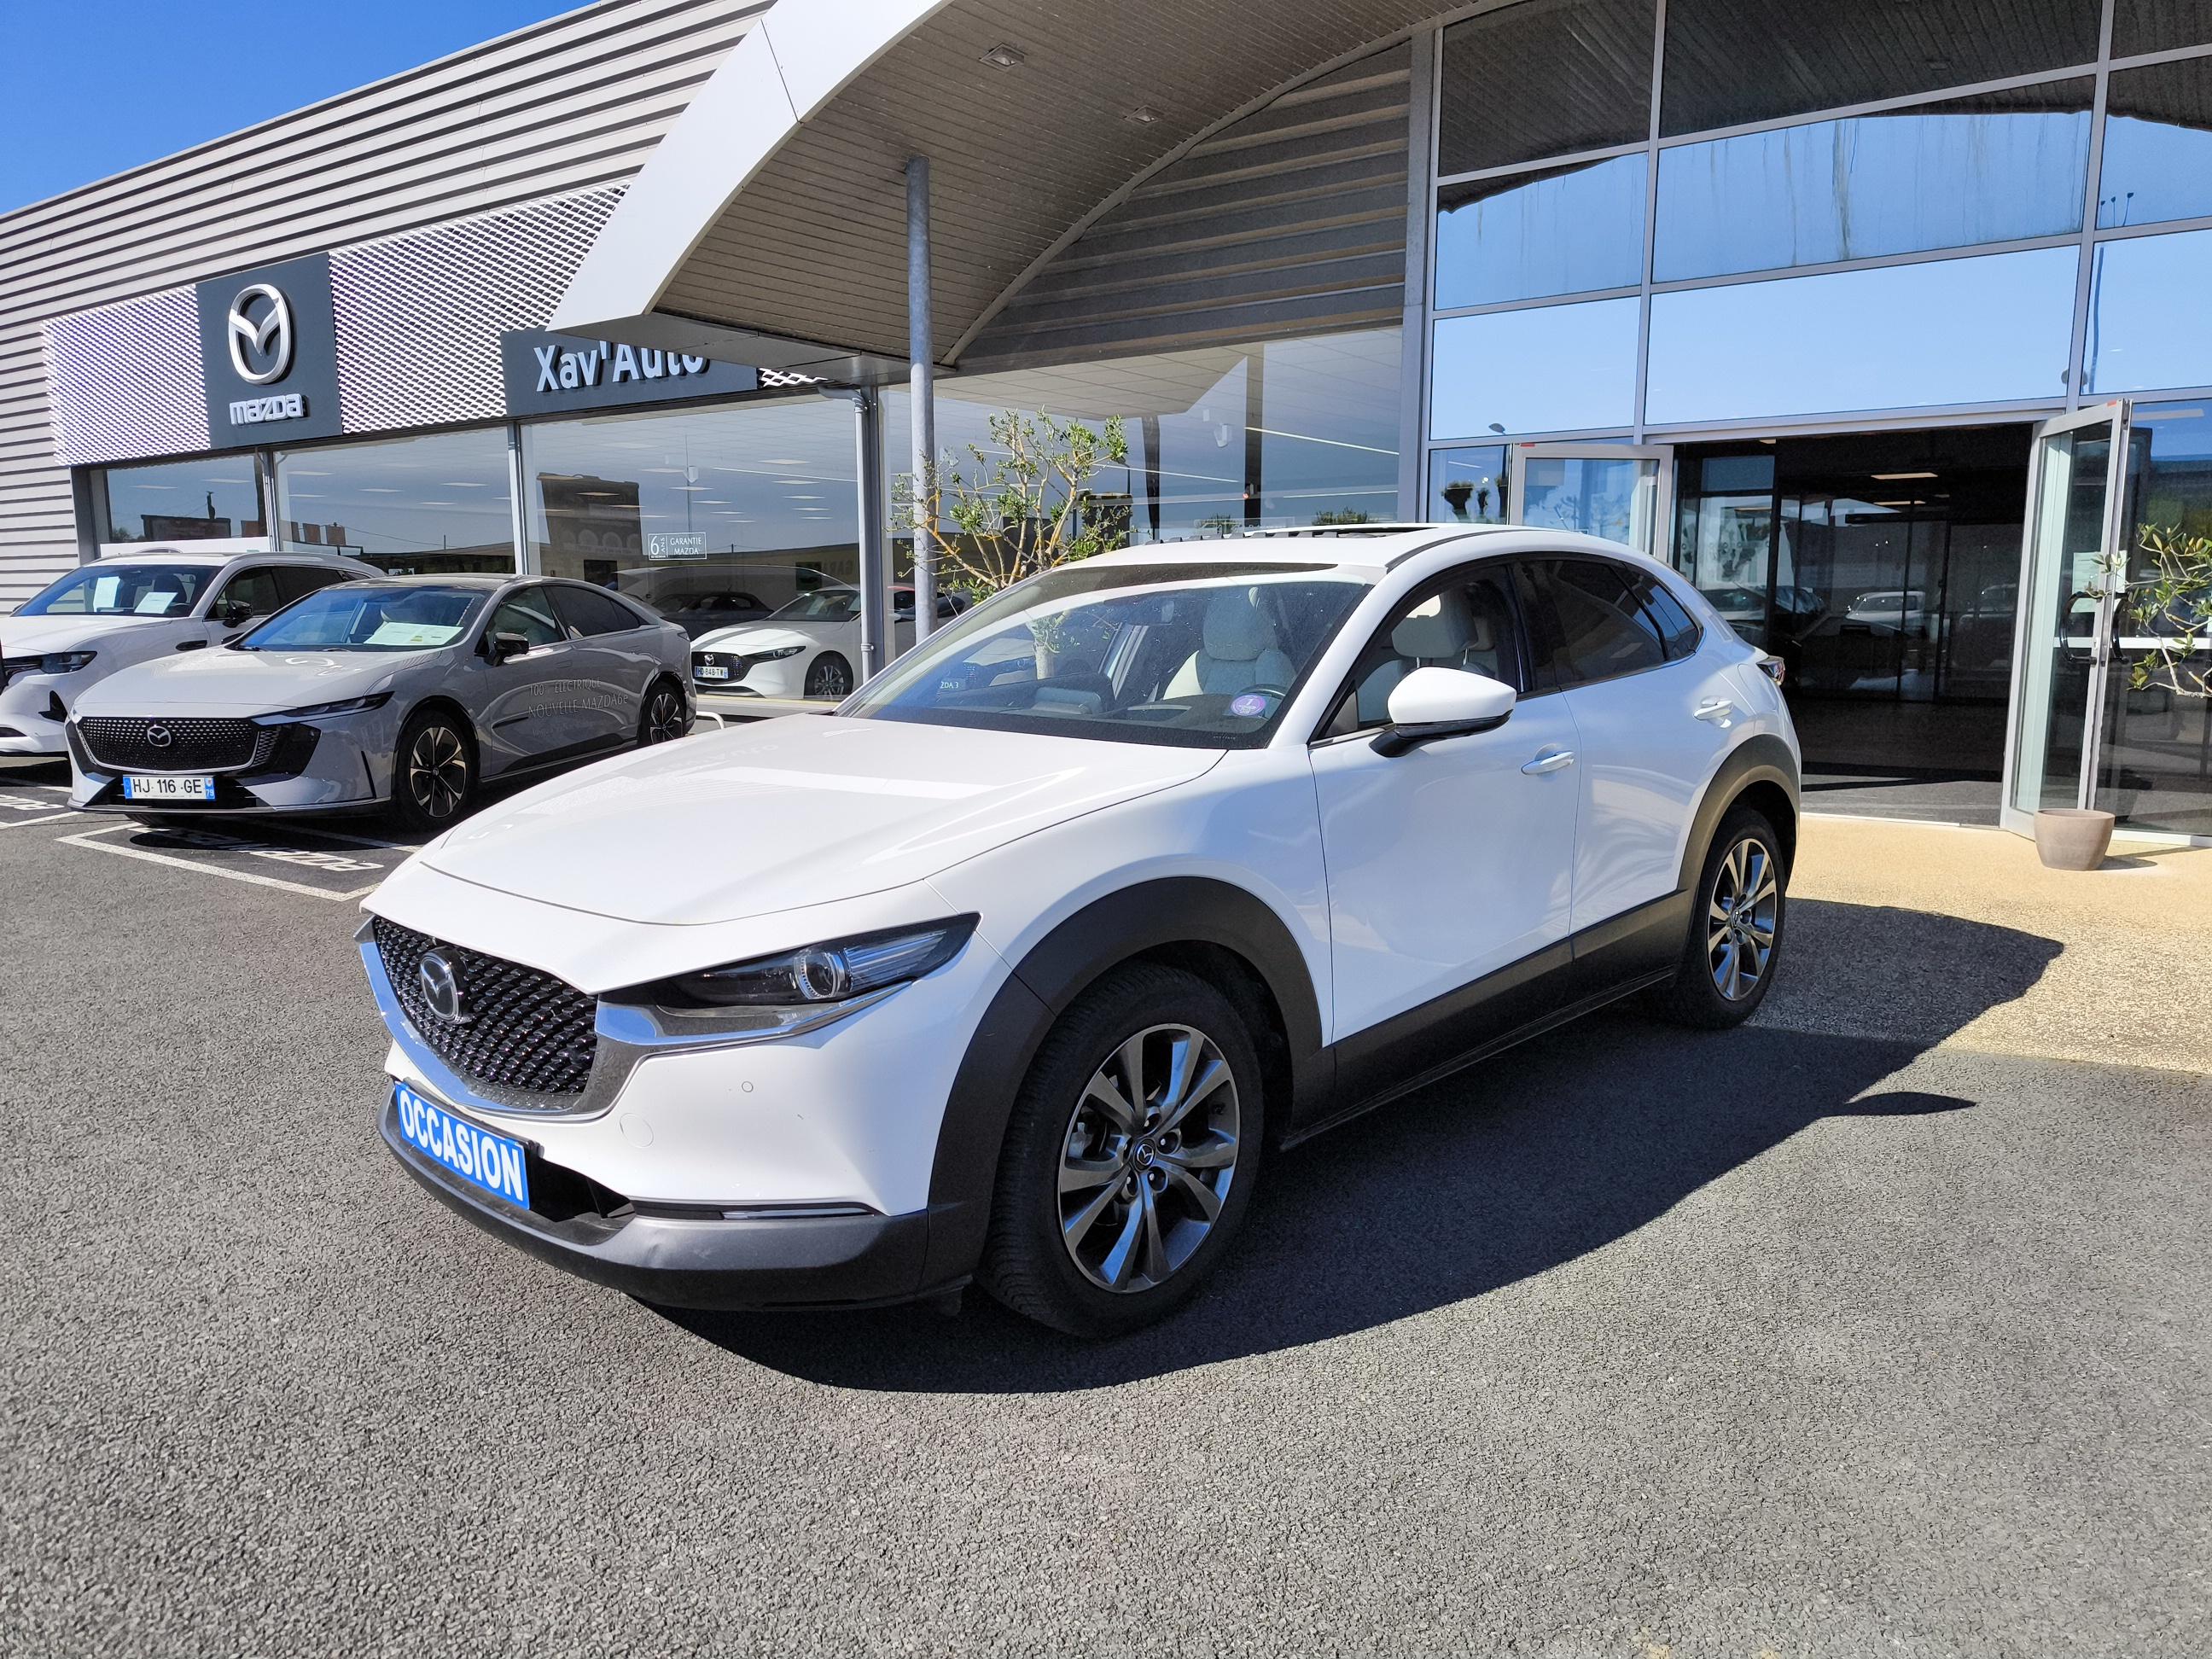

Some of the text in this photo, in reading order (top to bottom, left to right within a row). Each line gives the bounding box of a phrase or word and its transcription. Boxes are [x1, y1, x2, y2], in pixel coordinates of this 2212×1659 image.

[650, 535, 660, 556] 6
[670, 537, 702, 546] GARANTIE
[673, 547, 699, 556] MAZDA
[529, 699, 579, 719] NOUVELLE
[399, 1090, 523, 1202] OCCASION
